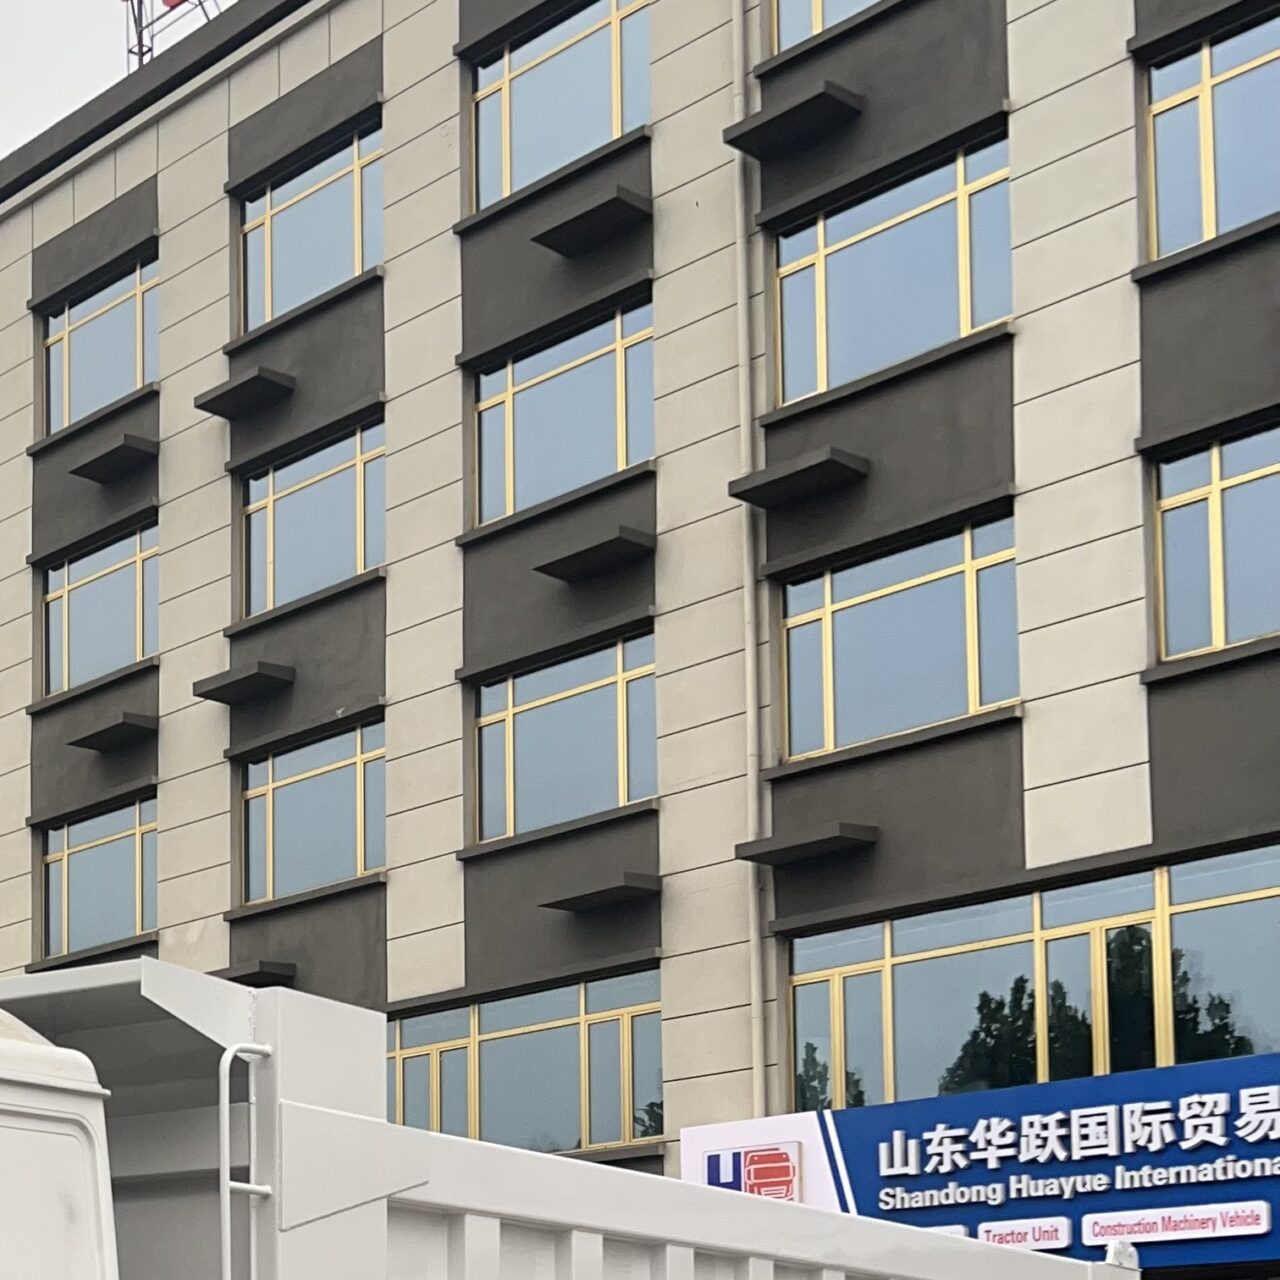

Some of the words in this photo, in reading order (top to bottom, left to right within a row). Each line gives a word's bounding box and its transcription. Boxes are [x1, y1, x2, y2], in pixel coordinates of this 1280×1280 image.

[878, 1084, 1280, 1177] 山东华跃国际贸易
[878, 1181, 1005, 1210] Shandong
[1009, 1172, 1111, 1200] Huayue
[984, 1225, 1028, 1244] Tractor
[1032, 1224, 1060, 1242] Unit
[1092, 1217, 1158, 1238] Construction
[1161, 1213, 1218, 1233] Machinery
[1219, 1208, 1262, 1228] Vehicle
